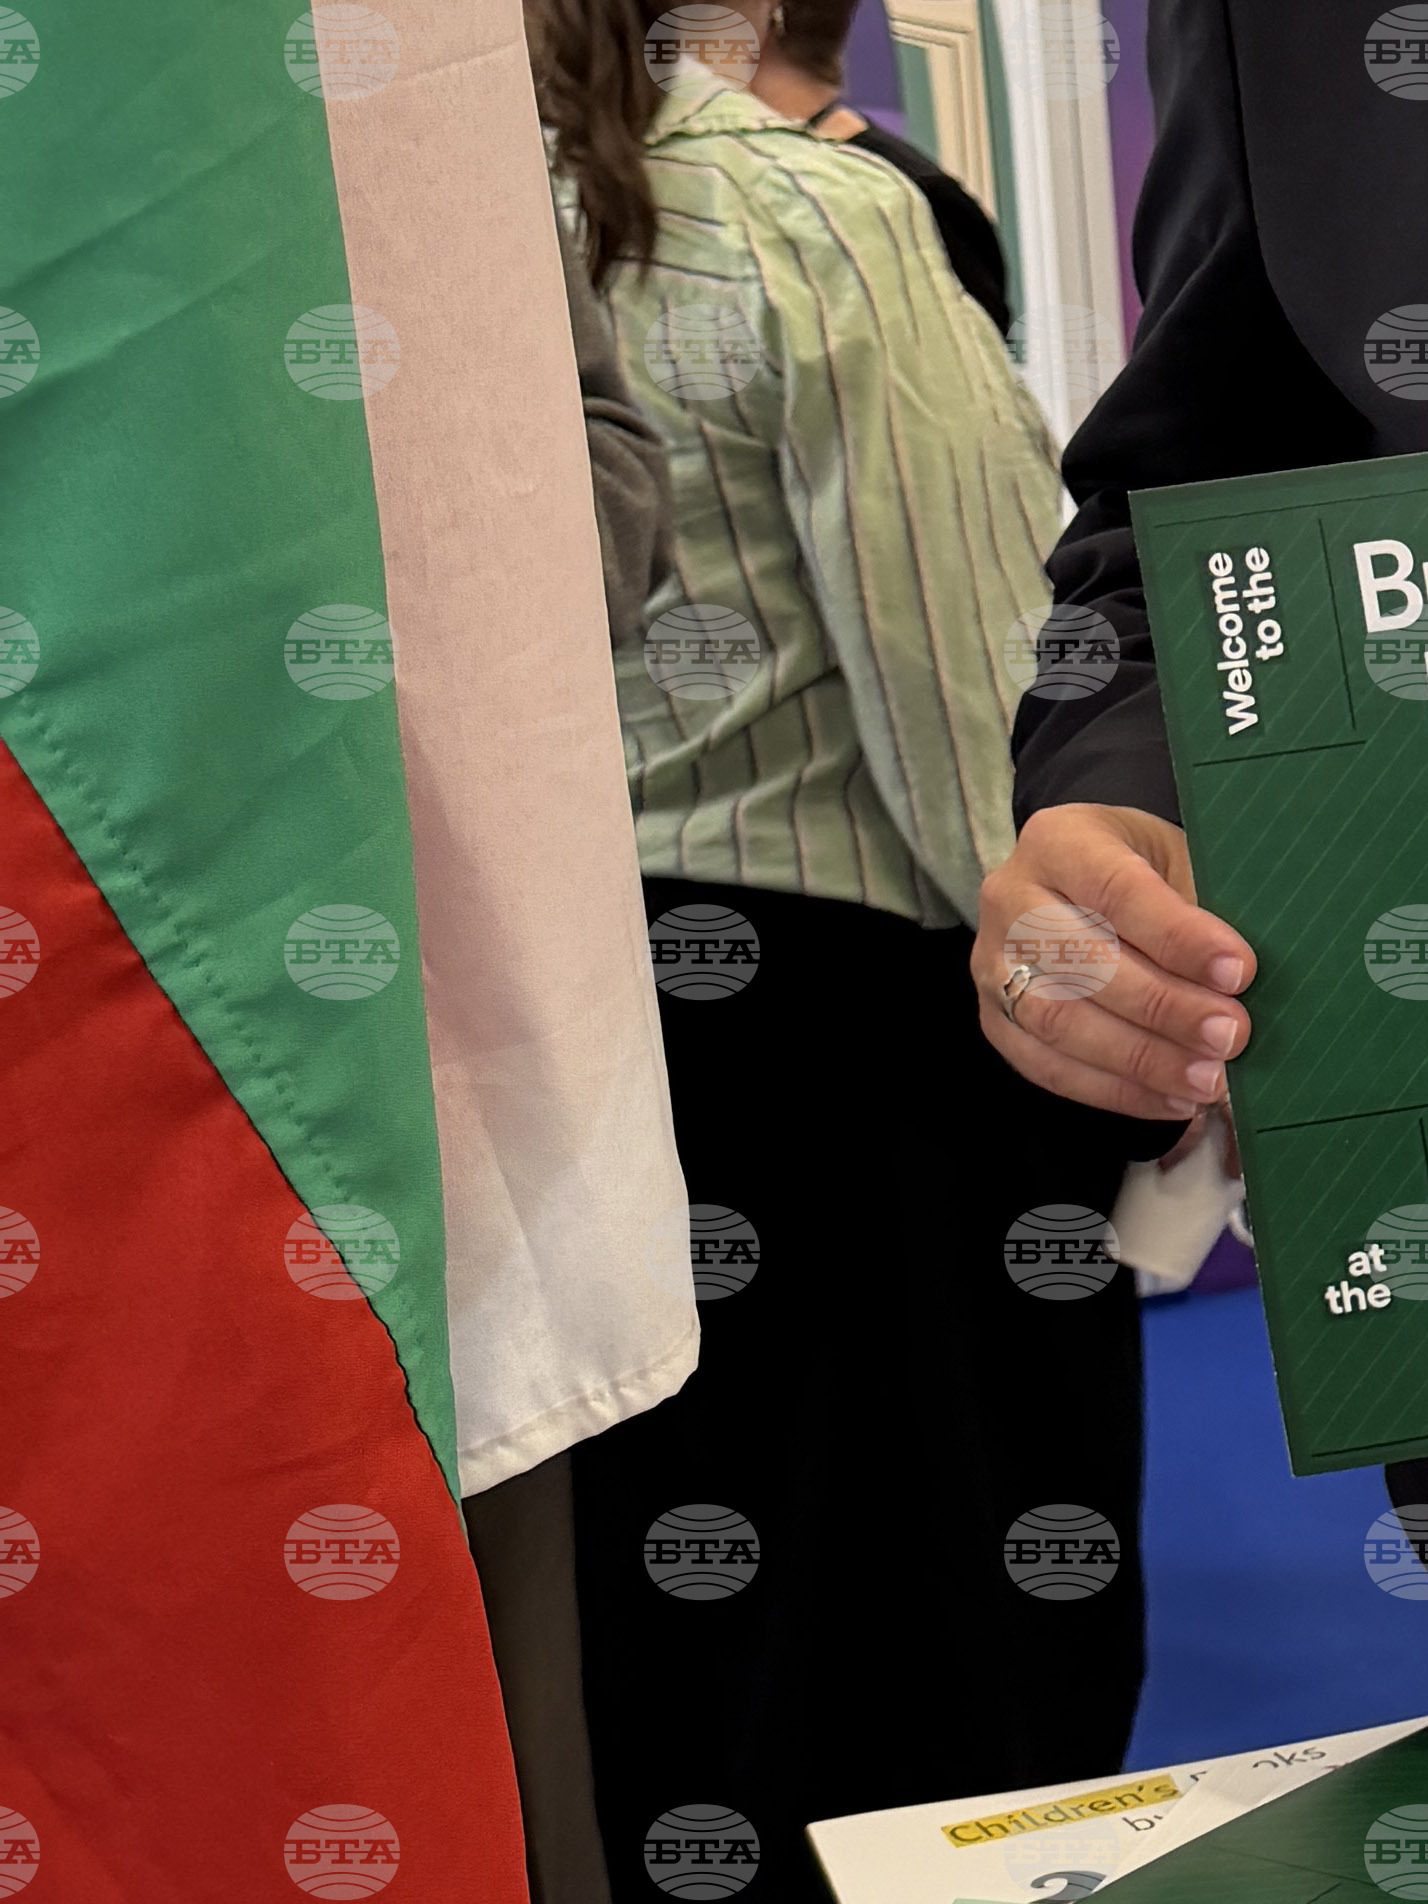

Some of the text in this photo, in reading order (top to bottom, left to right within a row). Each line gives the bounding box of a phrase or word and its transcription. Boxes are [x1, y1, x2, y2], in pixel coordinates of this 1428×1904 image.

[1242, 546, 1285, 661] to the
[1208, 551, 1259, 736] Welcome
[1346, 1244, 1388, 1278] at
[1323, 1278, 1393, 1317] the
[948, 1773, 1181, 1845] Children's
